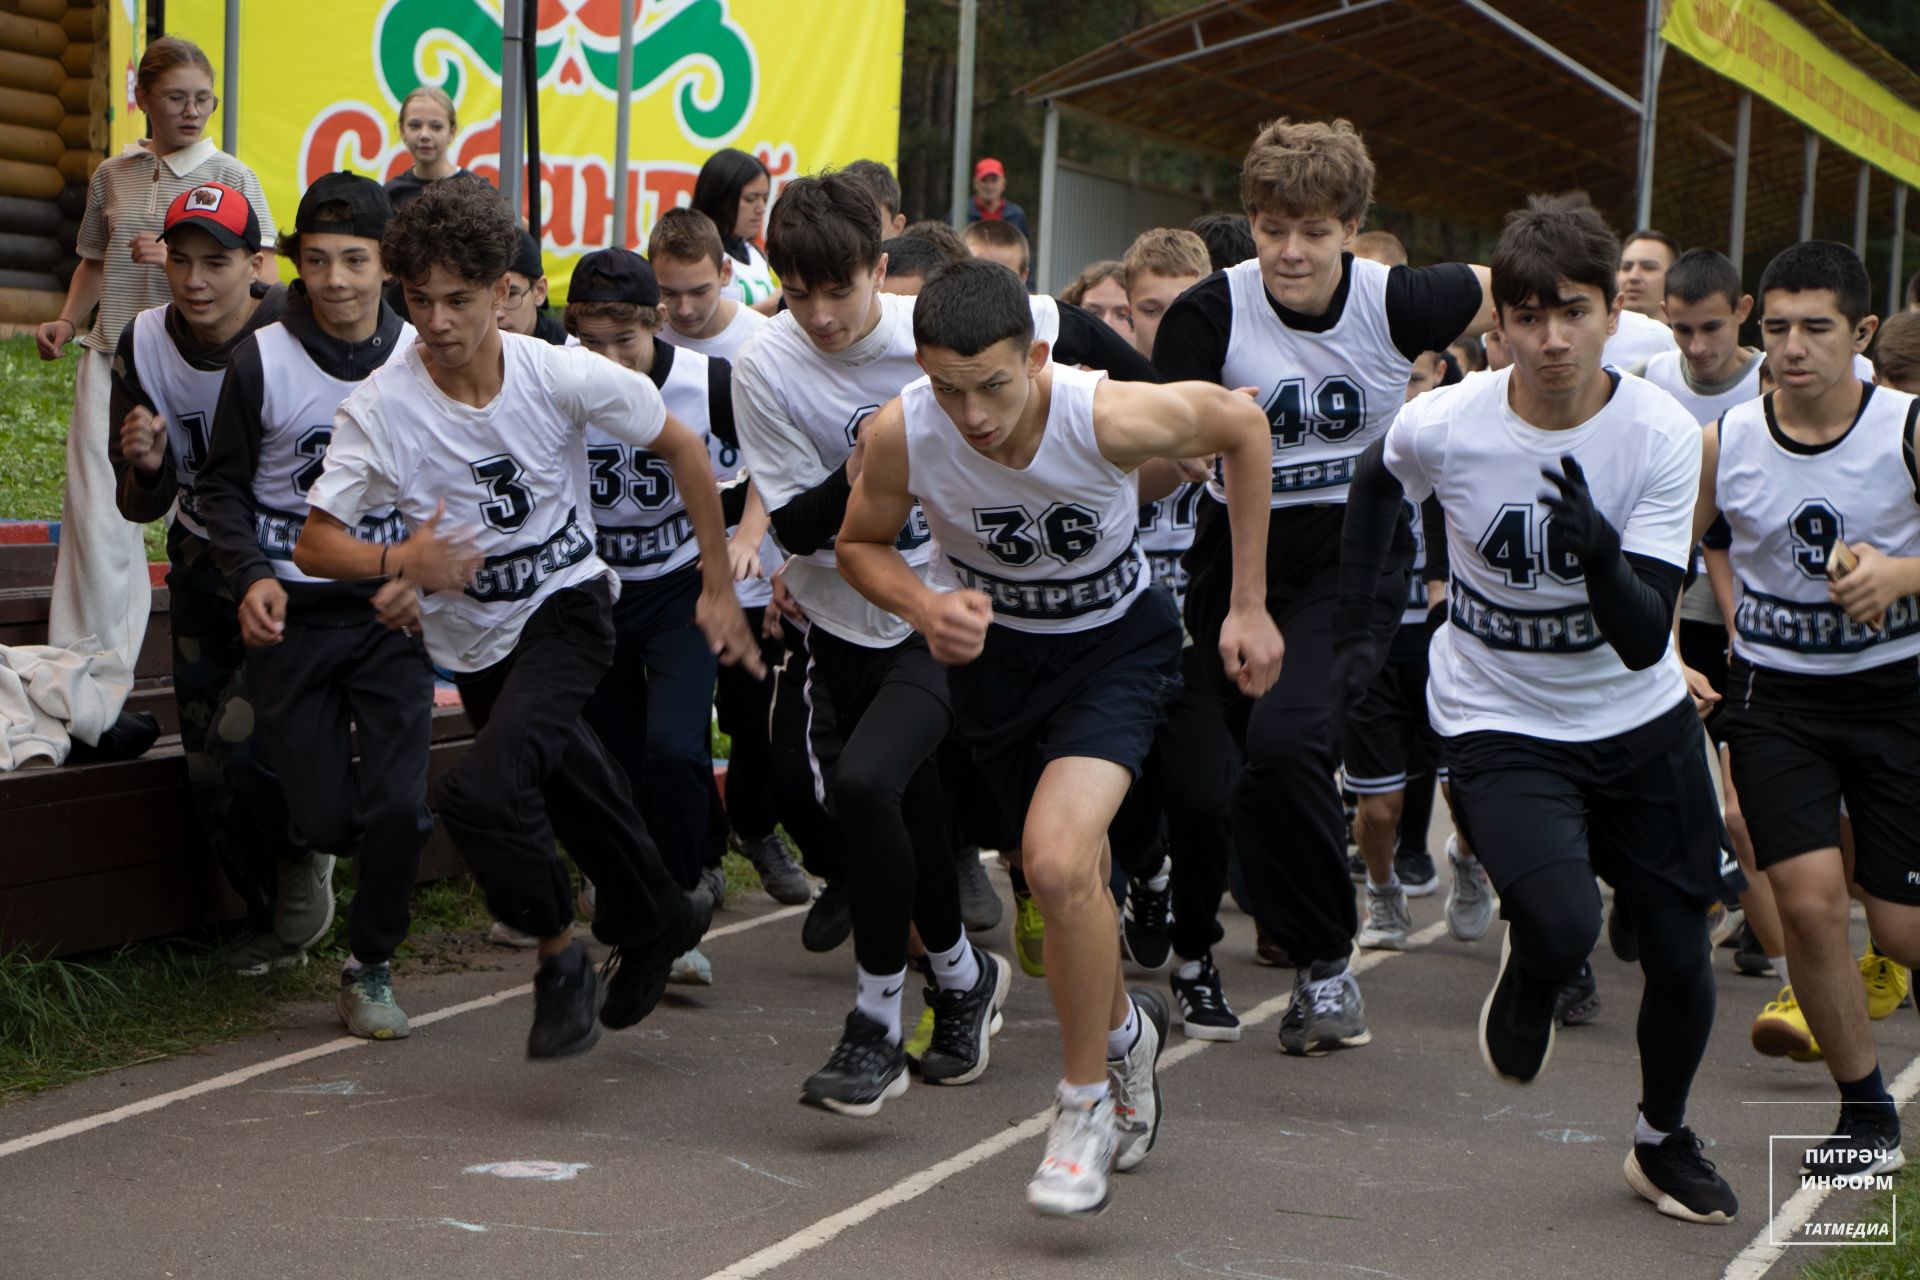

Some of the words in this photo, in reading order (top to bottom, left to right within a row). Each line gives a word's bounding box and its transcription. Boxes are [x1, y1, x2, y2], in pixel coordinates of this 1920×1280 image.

[1264, 375, 1367, 449] 49
[291, 425, 334, 498] 2
[470, 453, 536, 534] 3
[587, 443, 675, 511] 35
[972, 502, 1103, 568] 36
[1787, 497, 1844, 581] 9
